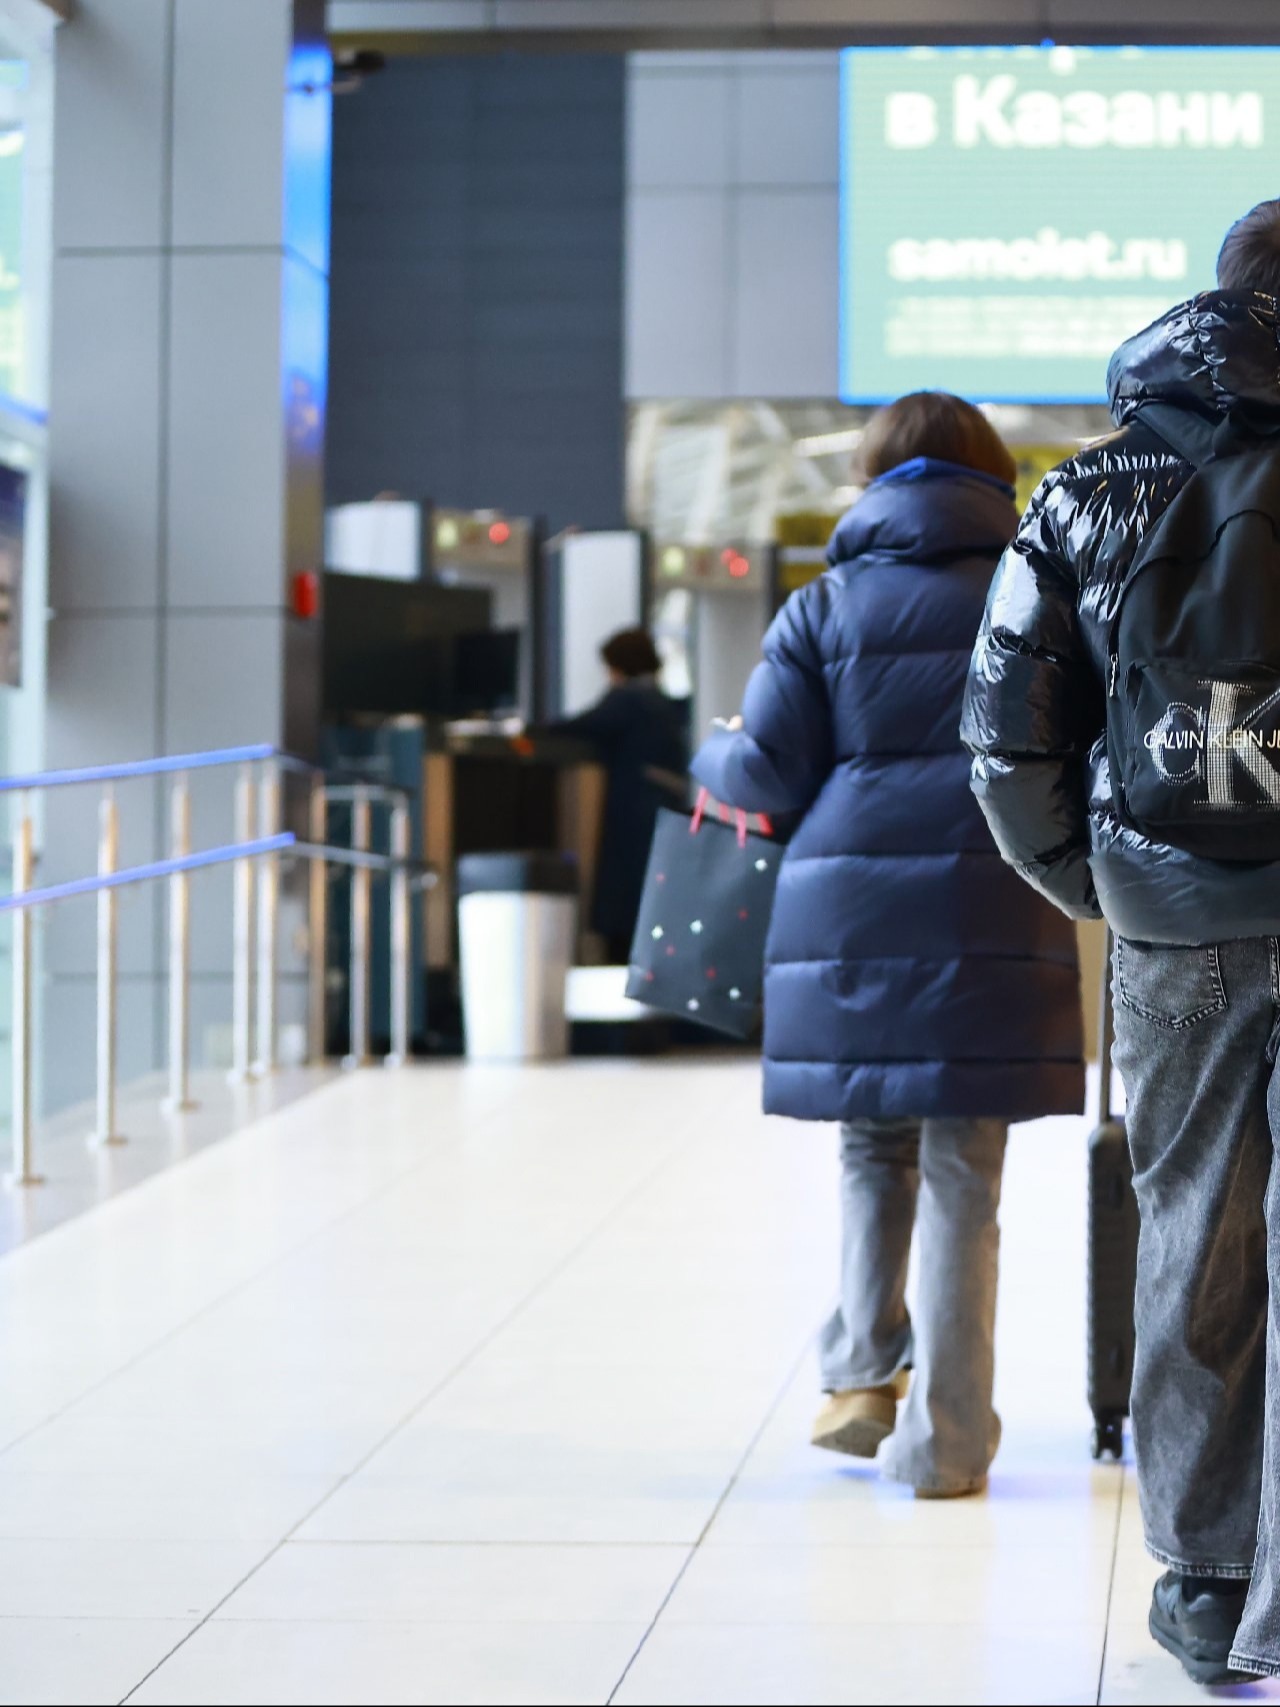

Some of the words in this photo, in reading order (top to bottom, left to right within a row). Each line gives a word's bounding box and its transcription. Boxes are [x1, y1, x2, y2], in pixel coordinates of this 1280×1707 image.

[885, 90, 938, 149] в
[951, 72, 1264, 150] Казани
[889, 228, 1187, 280] samolet.ru
[1143, 729, 1204, 750] CALVIN
[1209, 728, 1263, 750] KLEIN
